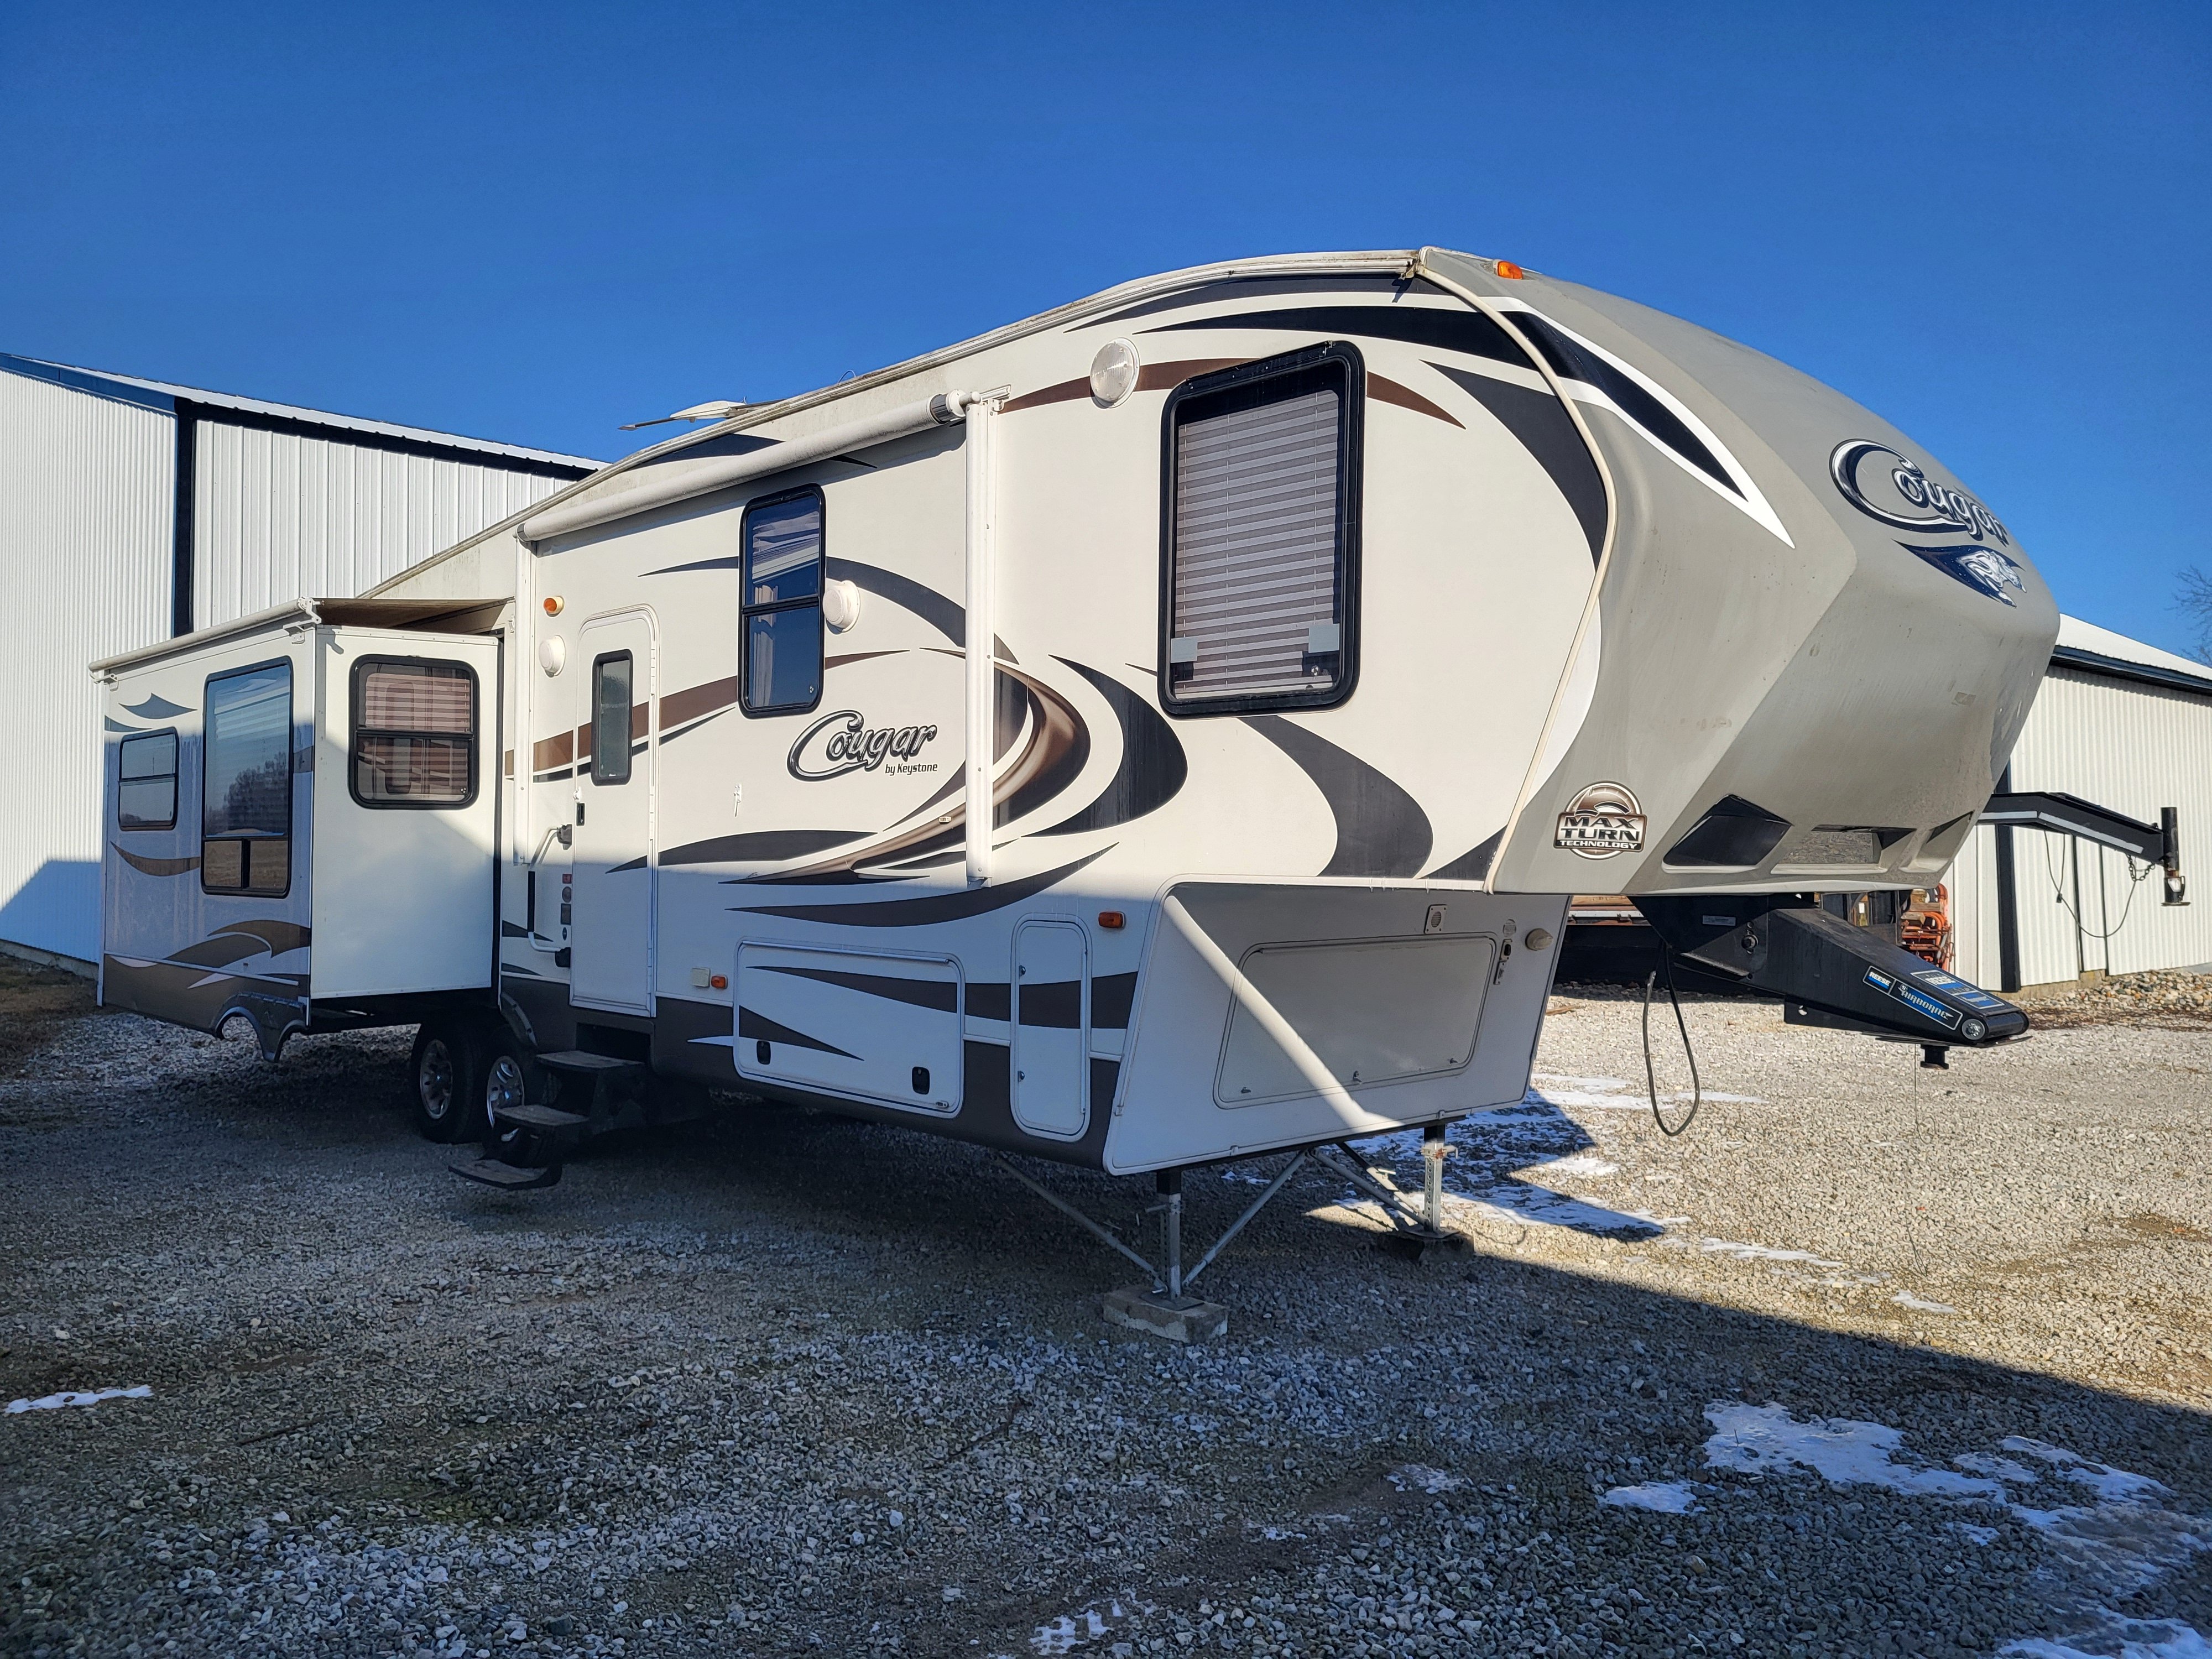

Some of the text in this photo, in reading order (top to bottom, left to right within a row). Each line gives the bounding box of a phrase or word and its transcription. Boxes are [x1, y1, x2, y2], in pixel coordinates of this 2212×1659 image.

[1829, 439, 2010, 547] Cougar
[787, 709, 937, 781] Cougar
[885, 763, 938, 776] by Keystone
[1565, 816, 1639, 829] MAX
[1561, 828, 1640, 841] TURN
[1560, 841, 1637, 849] TECHNOLOGY
[1869, 972, 1891, 986] REESE
[1898, 988, 1954, 1020] AIRBORNE
